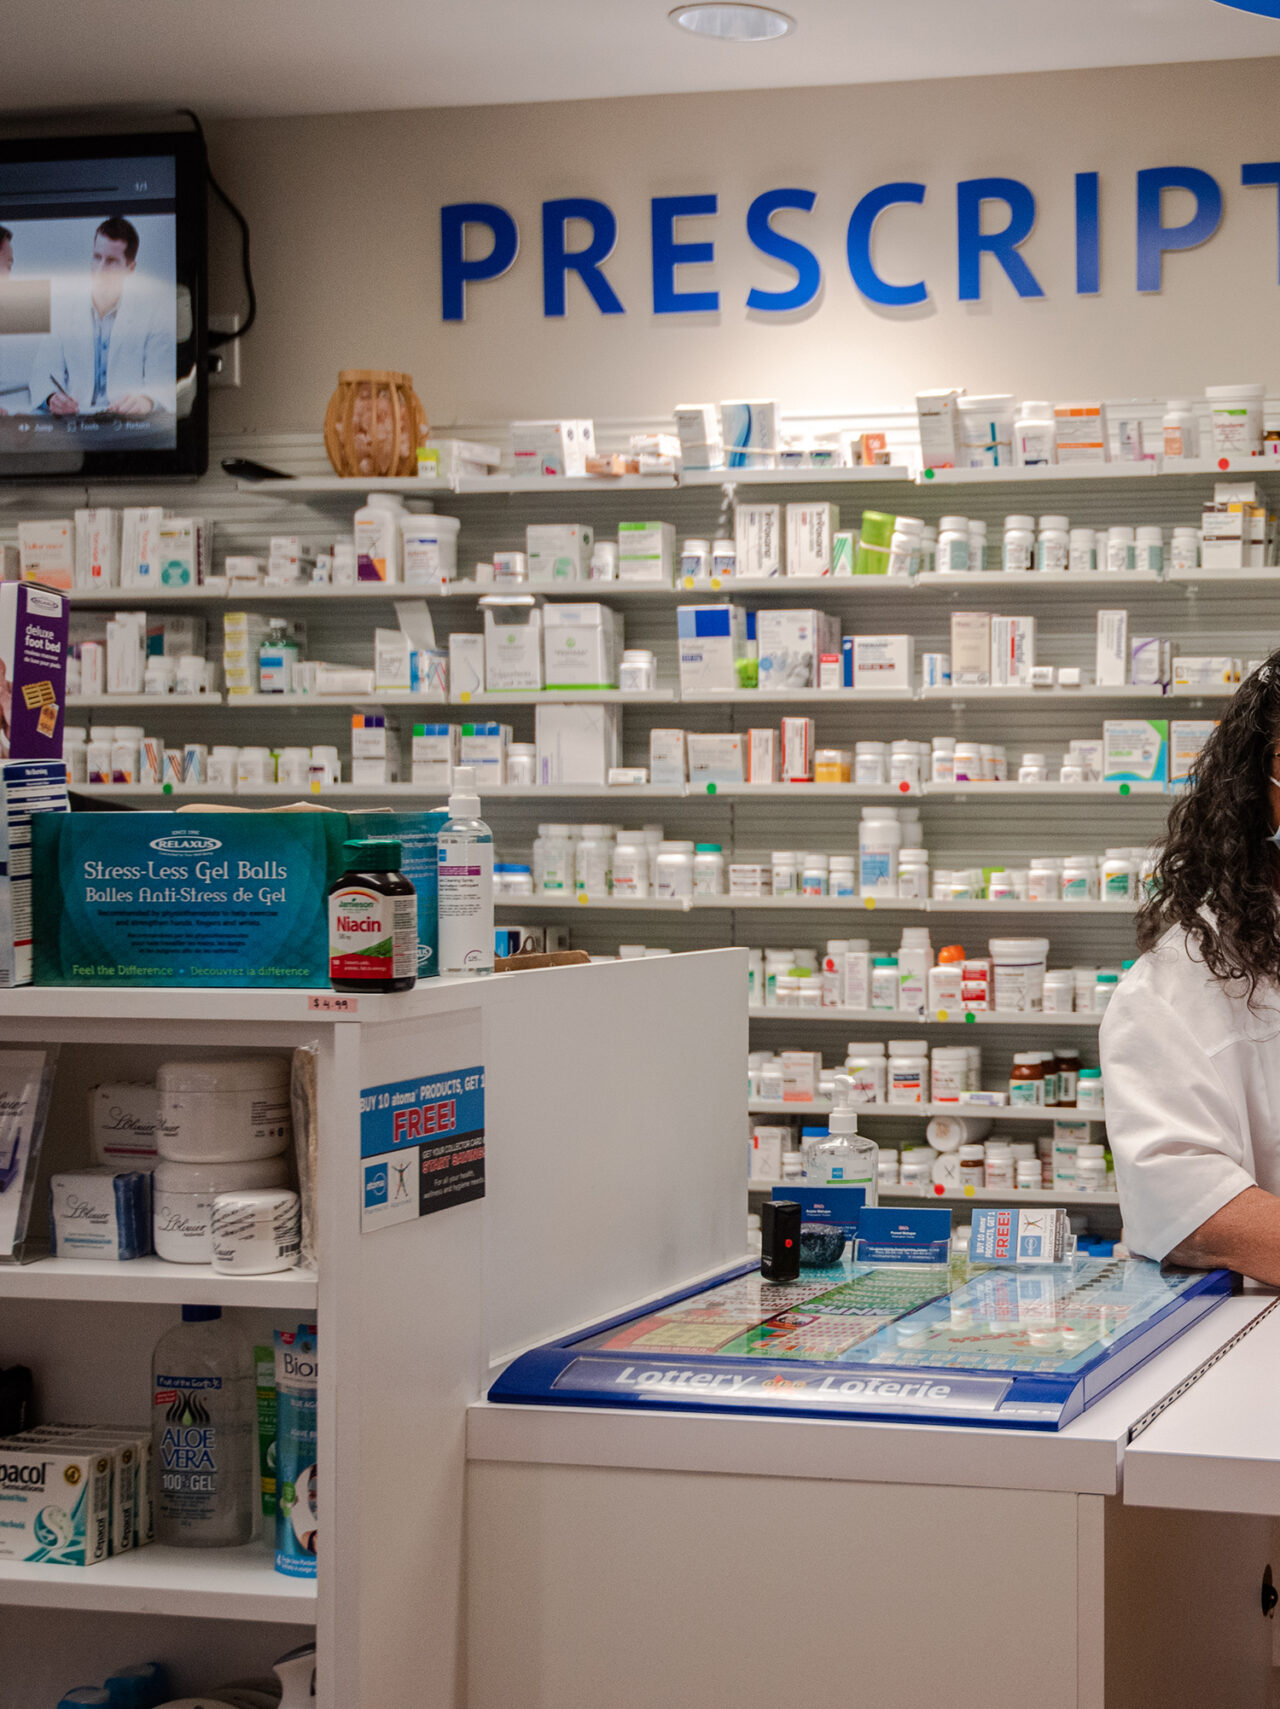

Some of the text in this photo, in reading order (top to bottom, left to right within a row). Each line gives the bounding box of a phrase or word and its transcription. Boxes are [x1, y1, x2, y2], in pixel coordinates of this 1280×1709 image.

[25, 624, 55, 640] deluxe
[24, 635, 61, 653] foot bed
[157, 840, 215, 850] RELAXUS
[84, 861, 288, 883] Stress-Less Gel Balls
[86, 887, 286, 905] Balles Anti-Stress de Gel
[336, 916, 382, 932] Niacin
[72, 965, 95, 975] Feel
[97, 965, 116, 975] the
[117, 965, 173, 975] Difference
[360, 1097, 377, 1113] BUY
[378, 1093, 390, 1110] 10
[464, 1075, 480, 1091] GET
[393, 1099, 457, 1143] FREE!
[995, 1211, 1011, 1258] FREE!
[615, 1366, 952, 1399] Lottery Loterie
[160, 1427, 217, 1449] ALOE
[161, 1448, 218, 1471] VERA
[190, 1474, 217, 1491] GEL
